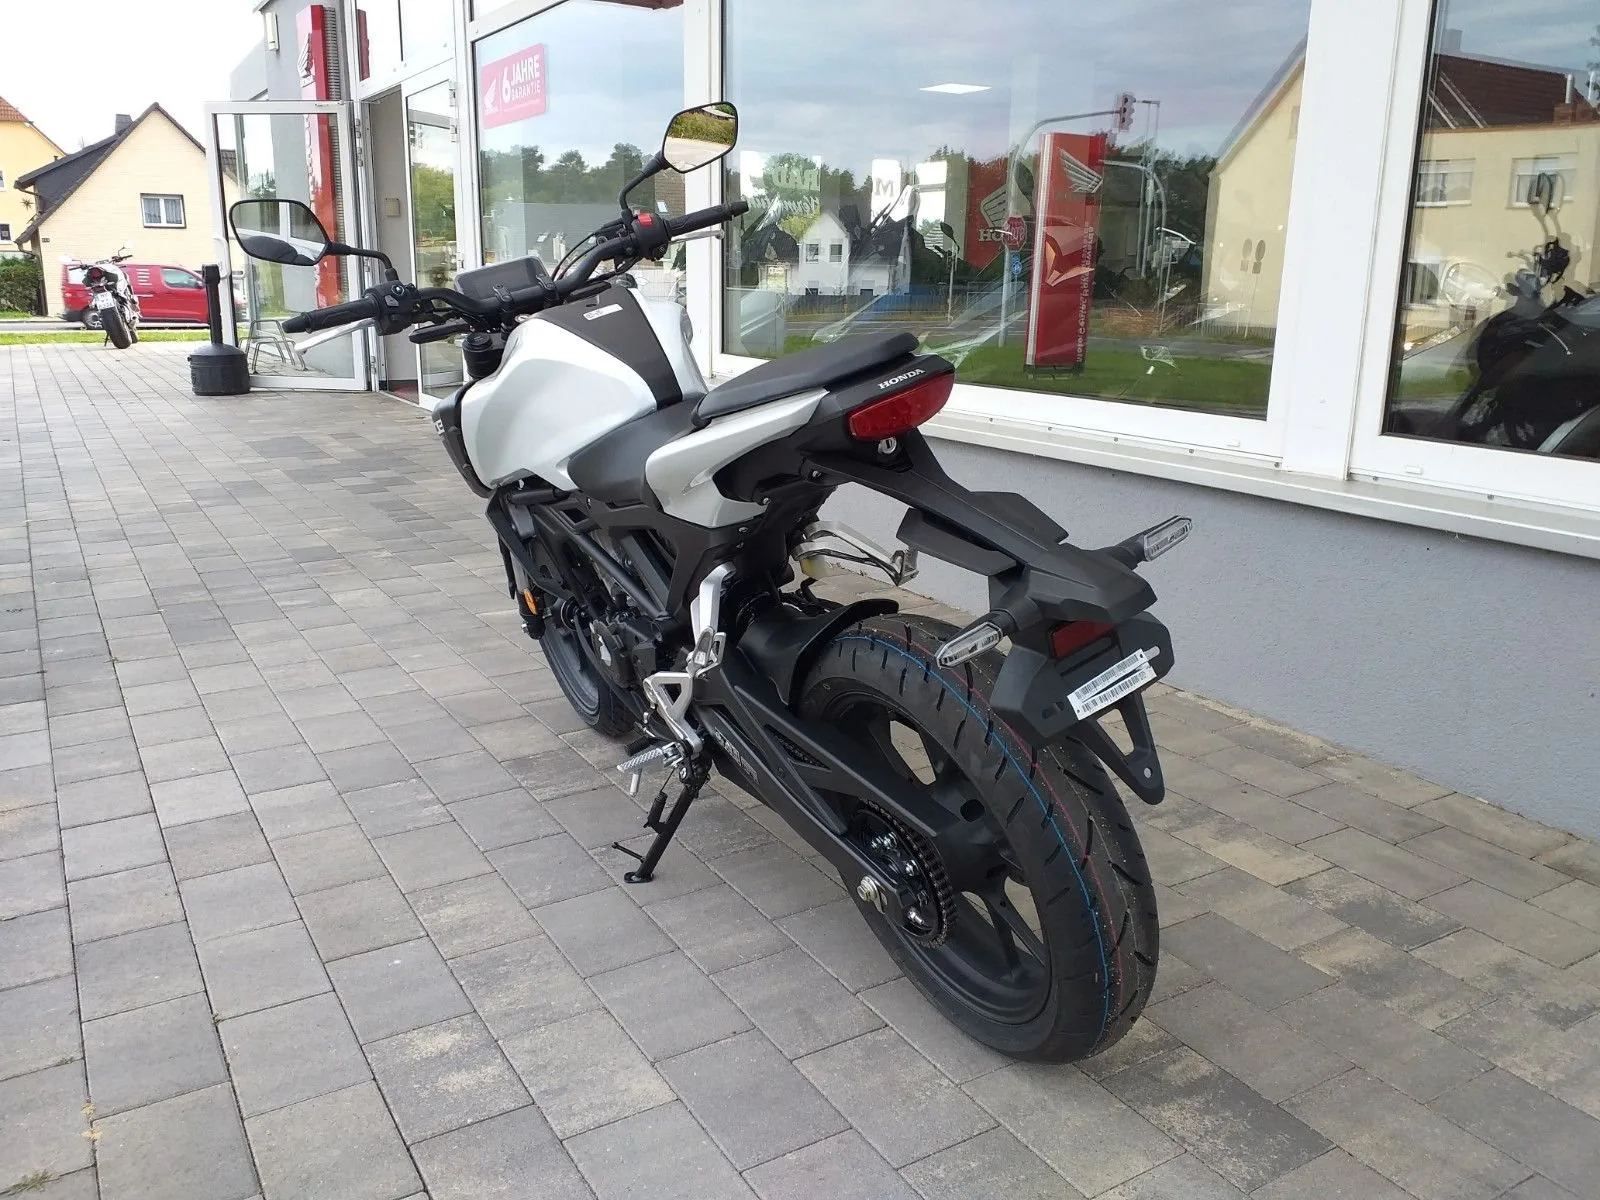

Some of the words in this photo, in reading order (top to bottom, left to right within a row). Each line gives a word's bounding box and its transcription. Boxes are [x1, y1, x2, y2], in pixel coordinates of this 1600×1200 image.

[502, 66, 511, 104] 6
[511, 54, 540, 86] JAHRE
[878, 368, 926, 390] HONDA
